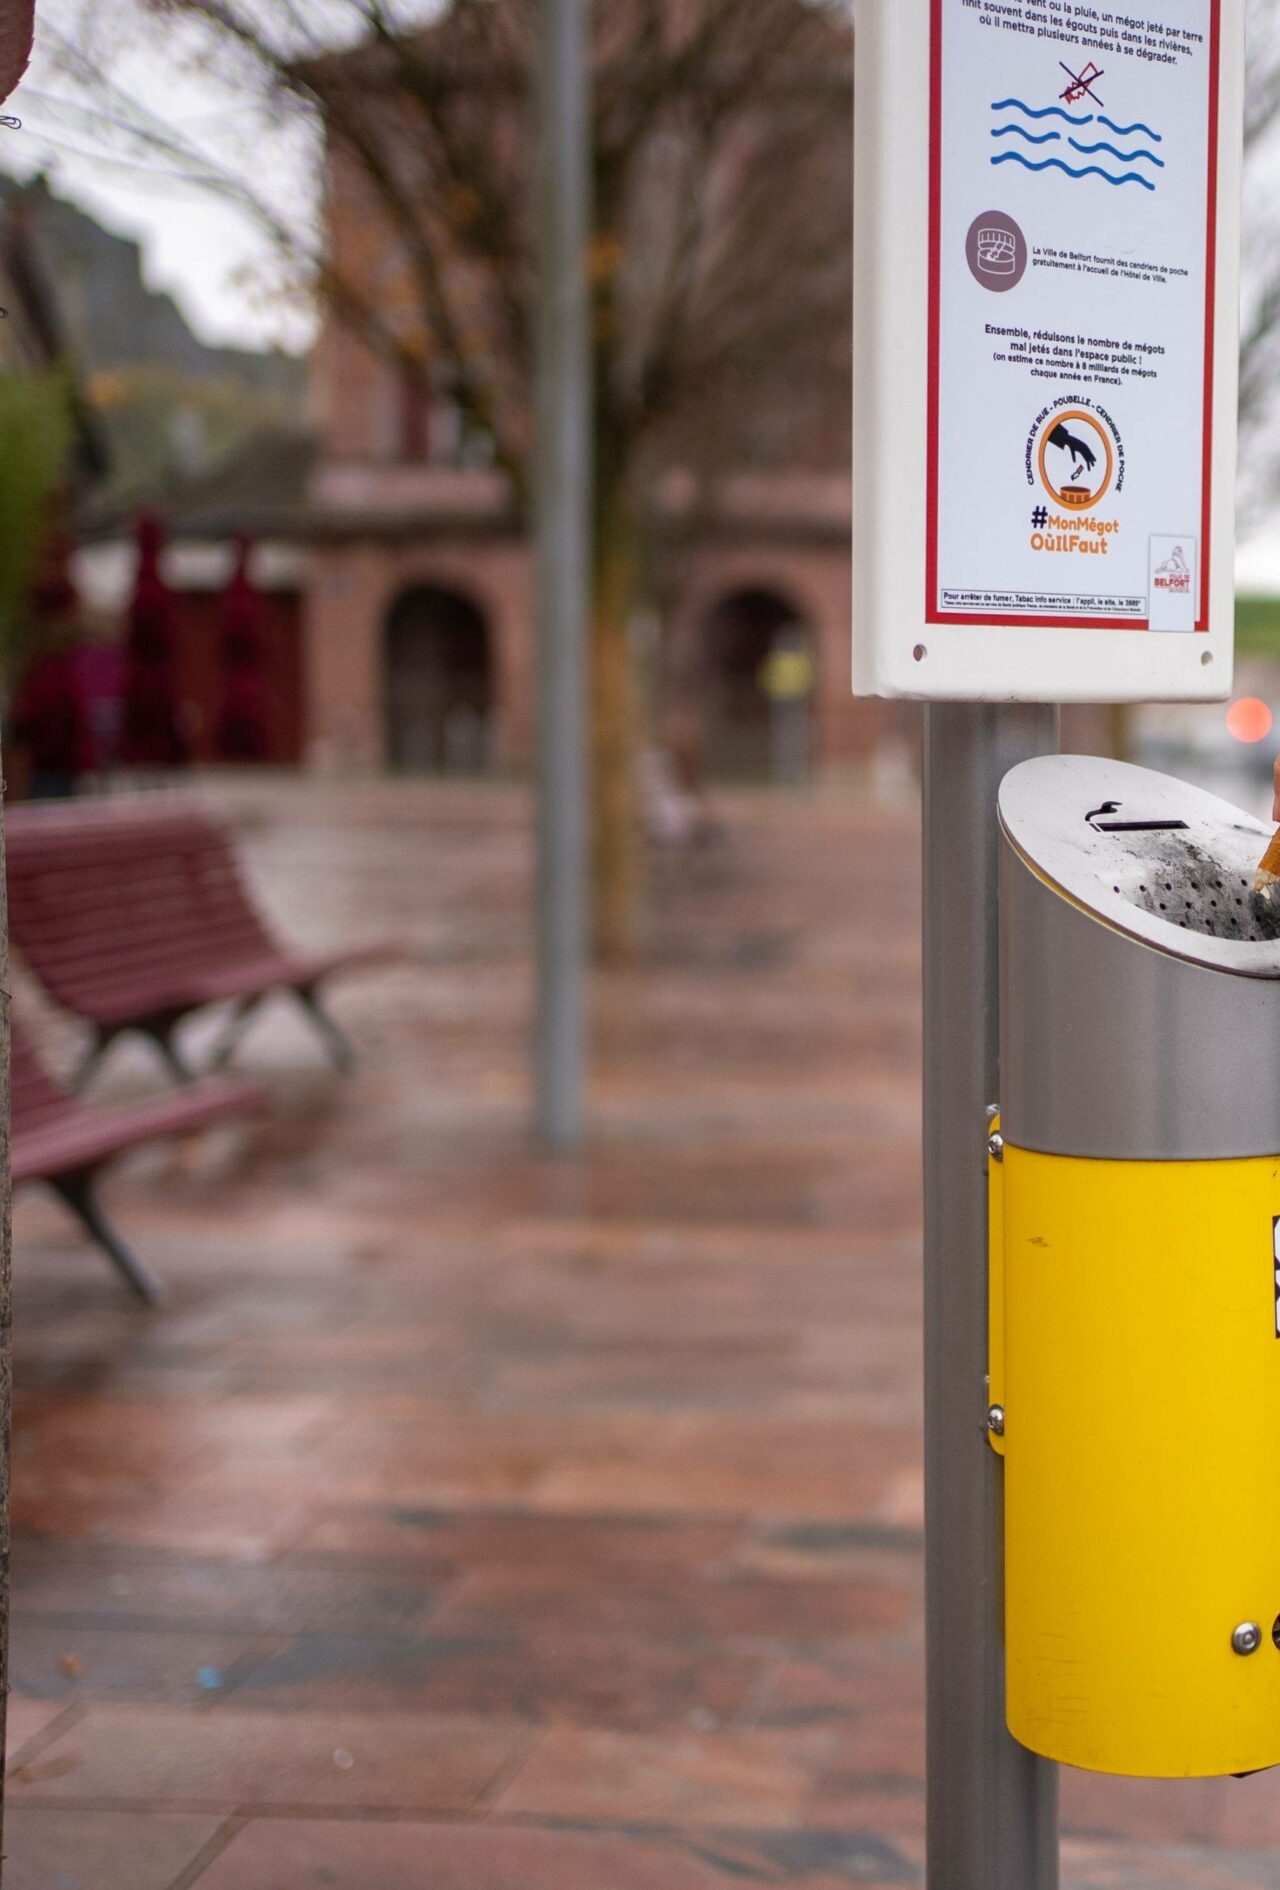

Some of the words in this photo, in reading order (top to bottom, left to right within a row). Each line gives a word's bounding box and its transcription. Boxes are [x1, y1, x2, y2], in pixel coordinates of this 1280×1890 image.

[984, 2, 1022, 18] souvent
[1024, 10, 1048, 24] dans
[1050, 14, 1063, 26] les
[1066, 18, 1097, 34] égouts
[1100, 26, 1118, 38] puis
[1121, 30, 1142, 44] dans
[1144, 34, 1156, 47] les
[1158, 38, 1192, 56] rivières,
[1049, 2, 1061, 11] ou
[1064, 2, 1072, 13] la
[1074, 6, 1099, 21] pluie,
[1102, 12, 1113, 22] un
[1116, 16, 1144, 30] mégot
[1146, 21, 1163, 34] jeté
[1166, 27, 1180, 37] par
[1182, 30, 1203, 42] terre
[980, 14, 991, 26] où
[994, 16, 1000, 27] il
[1002, 20, 1034, 34] mettra
[1038, 26, 1079, 44] plusieurs
[1082, 36, 1114, 52] années
[1116, 42, 1122, 53] à
[1124, 46, 1134, 56] se
[1136, 48, 1178, 65] dégrader.
[1032, 246, 1041, 255] La
[1042, 248, 1057, 258] Ville
[1059, 250, 1068, 259] de
[1070, 252, 1092, 262] Belfort
[1094, 255, 1115, 265] fournit
[1116, 258, 1128, 268] des
[1130, 262, 1158, 272] cendriers
[1170, 268, 1188, 276] poche
[1032, 258, 1076, 270] gratuitement
[1083, 264, 1110, 275] l'accueil
[1120, 270, 1141, 279] l'Hôtel
[1152, 274, 1167, 283] Ville.
[985, 324, 1030, 340] Ensemble,
[1034, 330, 1075, 344] réduisons
[1077, 334, 1085, 344] le
[1088, 338, 1120, 349] nombre
[1122, 341, 1132, 350] de
[1135, 342, 1165, 354] mégots
[1010, 342, 1026, 351] mal
[1028, 342, 1050, 354] jetés
[1052, 346, 1072, 357] dans
[1075, 348, 1109, 361] l'espace
[1112, 354, 1136, 364] public
[993, 352, 1006, 361] (on
[1008, 354, 1033, 364] estime
[1046, 359, 1074, 369] nombre
[1082, 362, 1087, 370] 8
[1088, 363, 1119, 374] milliards
[1121, 366, 1129, 375] de
[1132, 368, 1157, 378] mégots
[1030, 368, 1057, 379] chaque
[1059, 370, 1081, 381] année
[1094, 374, 1122, 386] France).
[1030, 423, 1038, 438] DE
[1036, 406, 1050, 424] RUE
[1053, 395, 1092, 408] POUBELLE
[1096, 405, 1122, 444] CENDRIER
[1116, 444, 1124, 458] DE
[1031, 506, 1119, 536] #MonMégot
[944, 592, 959, 600] Pour
[961, 593, 982, 601] arrêter
[993, 594, 1014, 602] fumer,
[1154, 578, 1190, 588] BELFORT
